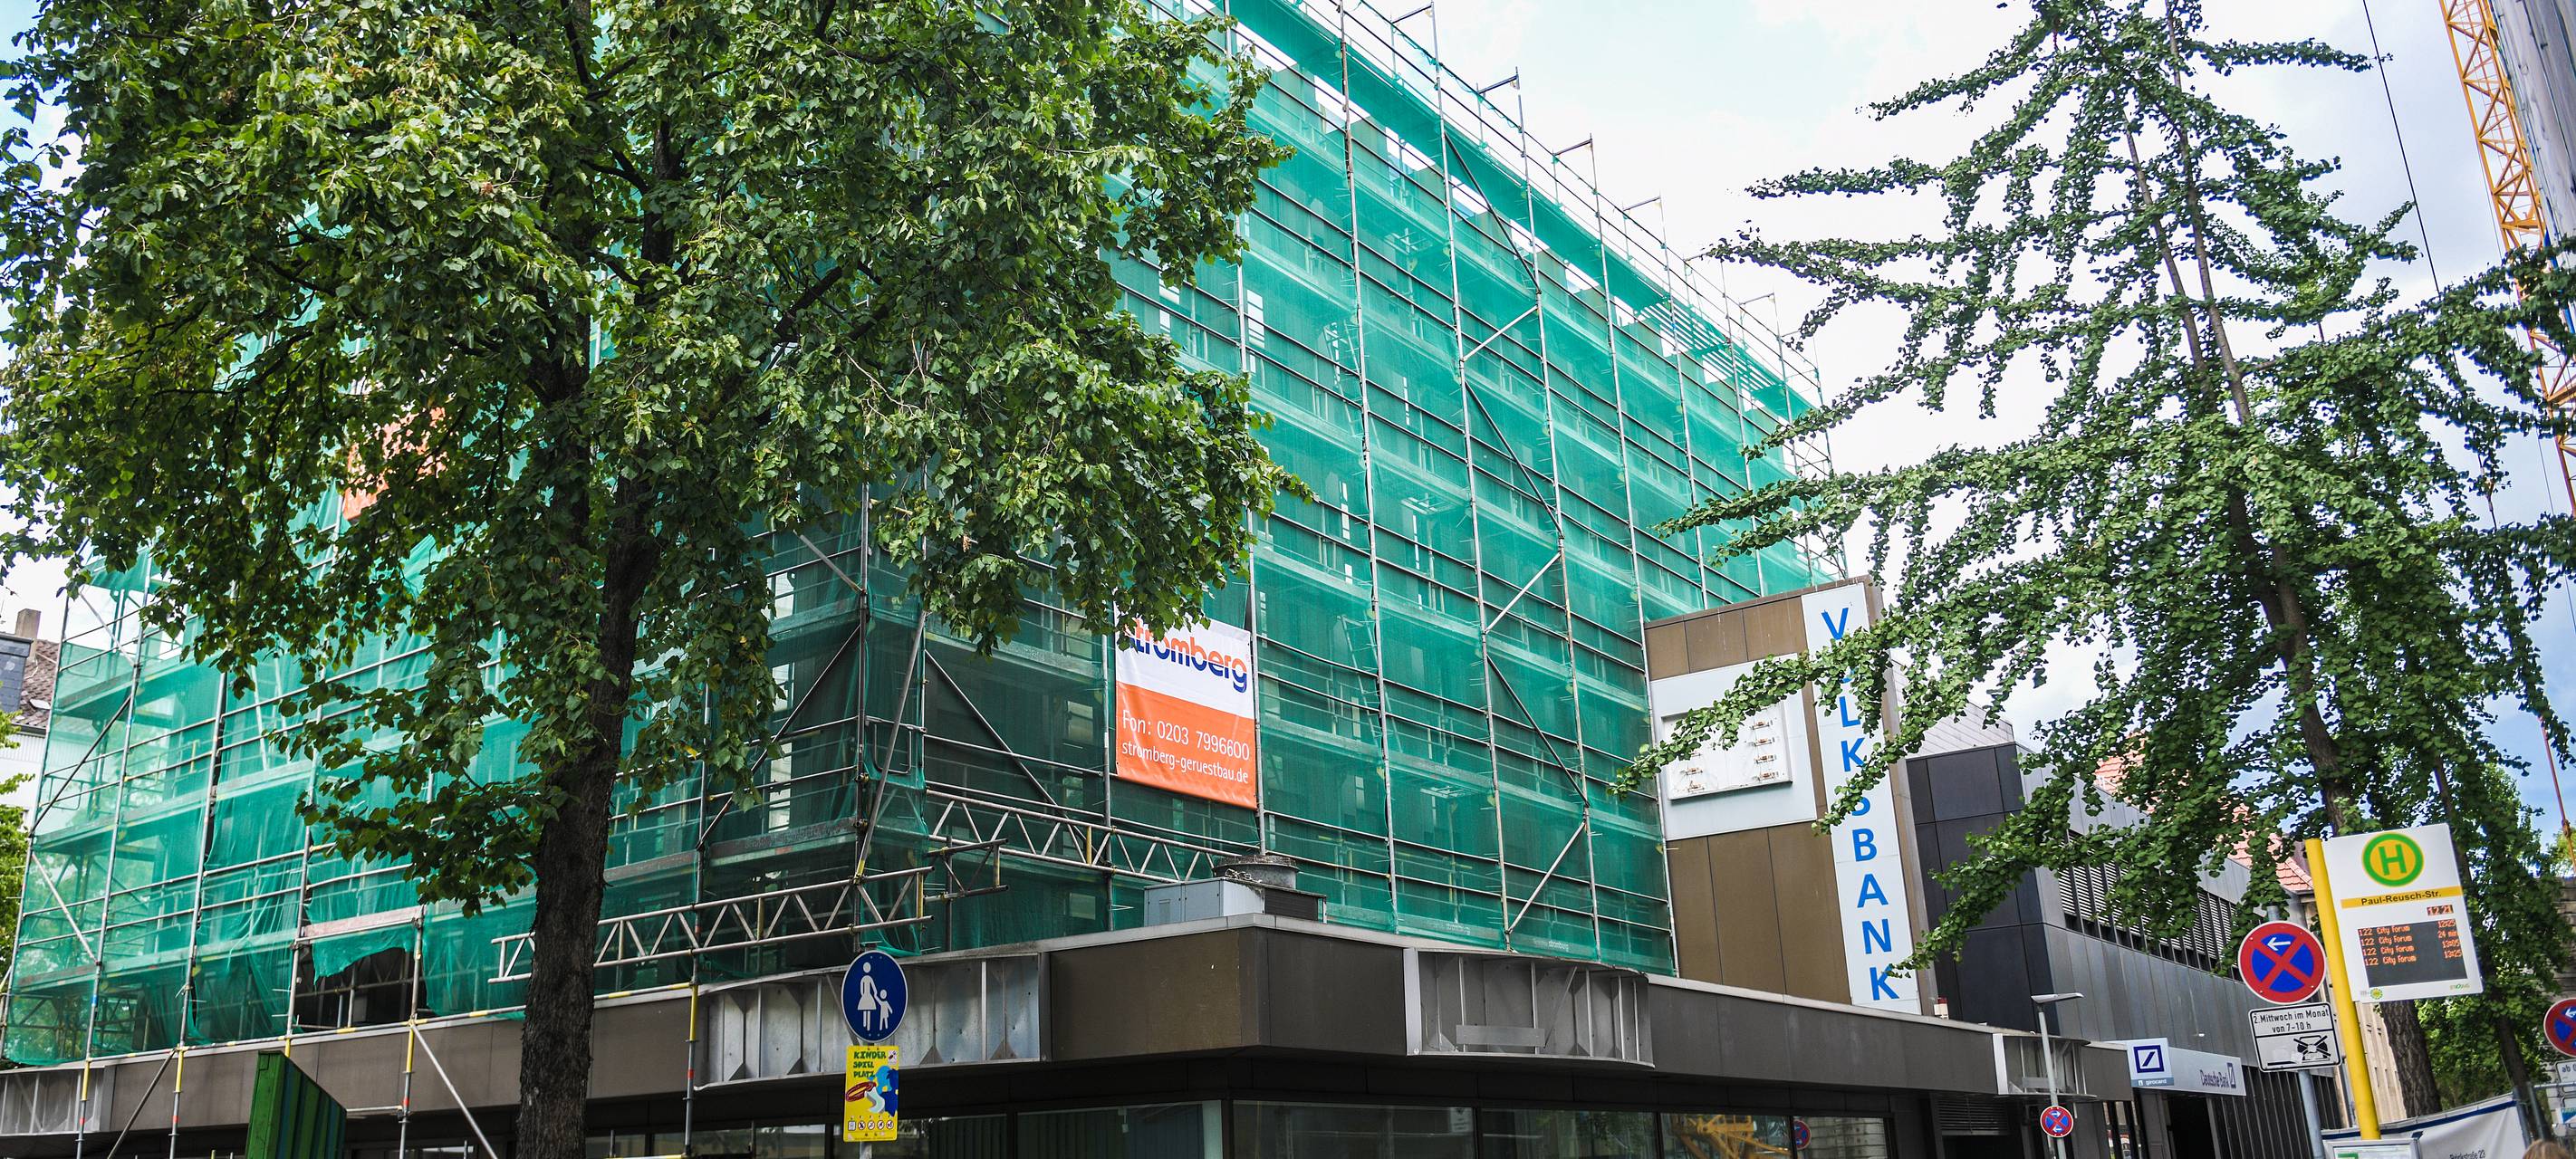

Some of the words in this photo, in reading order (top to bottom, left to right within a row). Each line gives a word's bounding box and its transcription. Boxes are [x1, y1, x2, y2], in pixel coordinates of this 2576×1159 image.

[1124, 617, 1247, 694] tromberg
[1122, 709, 1151, 735] Fon:
[1157, 721, 1189, 745] 0203
[1196, 731, 1250, 761] 7996600
[1121, 742, 1249, 784] stromberg-geruestbau.de
[1821, 608, 1899, 1001] VLKBANK
[2378, 844, 2408, 876] H
[2360, 890, 2442, 905] Paul-Reusch-Str.
[2376, 927, 2390, 935] City
[2360, 938, 2375, 946] 122
[2378, 937, 2392, 945] City
[2362, 948, 2378, 956] 122
[2380, 947, 2394, 955] City
[2365, 958, 2379, 966] 122
[2382, 956, 2397, 965] City
[2294, 1011, 2304, 1020] im
[2305, 1009, 2330, 1019] Monat
[2272, 1025, 2285, 1033] von
[2306, 1021, 2312, 1030] h
[854, 1050, 887, 1059] KINDER
[853, 1070, 876, 1078] PLATZ
[2145, 1078, 2167, 1087] girocard
